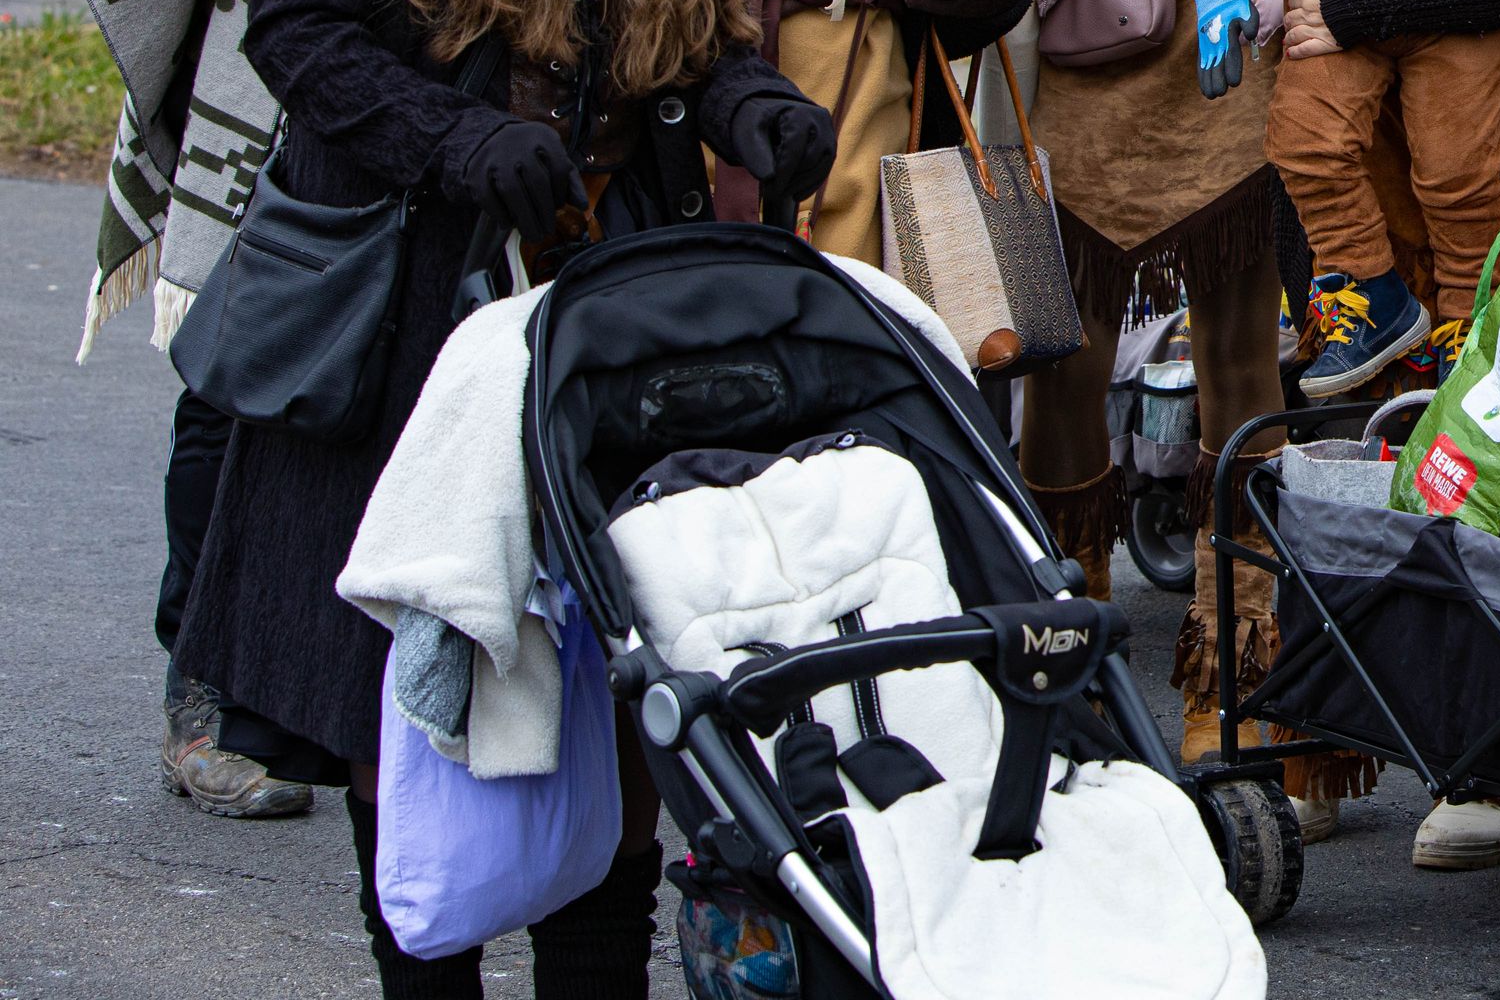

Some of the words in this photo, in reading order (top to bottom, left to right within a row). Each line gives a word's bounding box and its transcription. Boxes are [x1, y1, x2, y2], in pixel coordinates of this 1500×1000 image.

[1421, 462, 1436, 485] DEIN
[1434, 473, 1459, 501] MARKT
[1429, 446, 1467, 485] REWE
